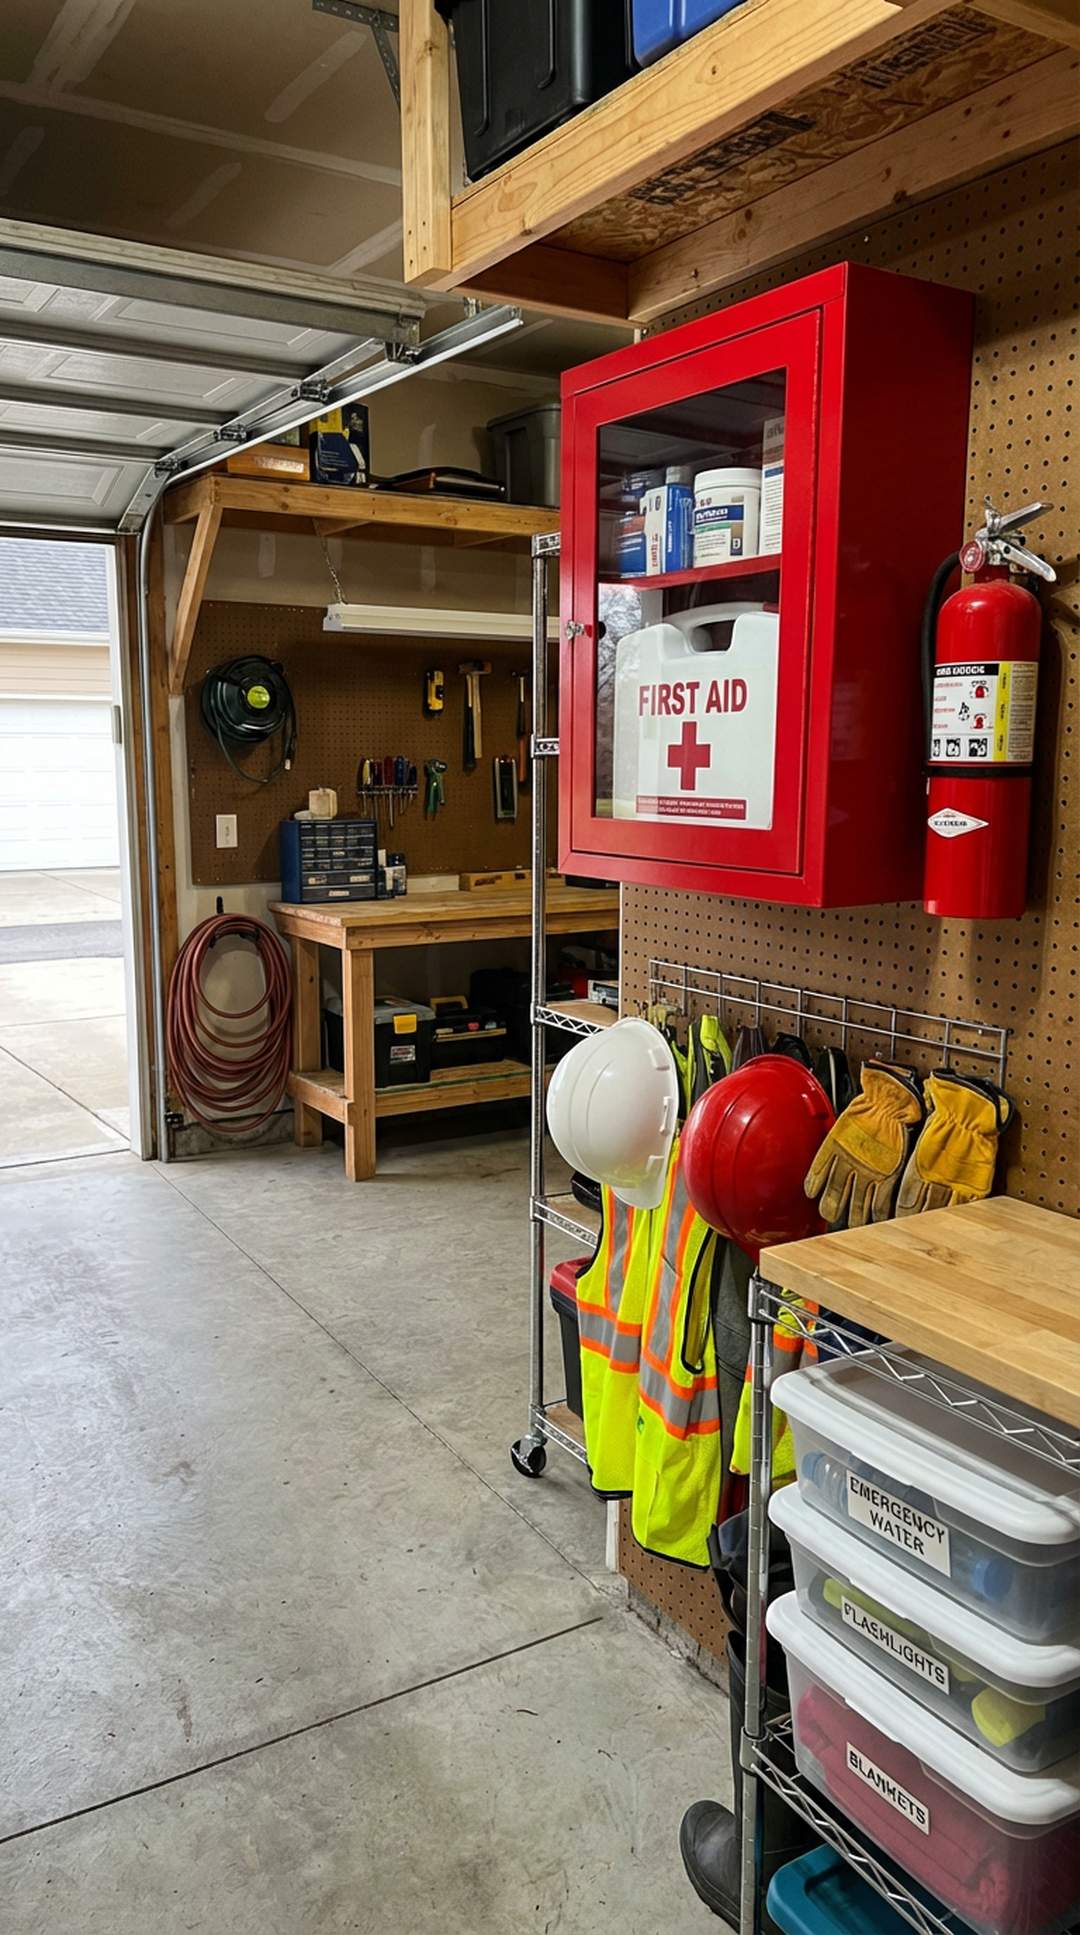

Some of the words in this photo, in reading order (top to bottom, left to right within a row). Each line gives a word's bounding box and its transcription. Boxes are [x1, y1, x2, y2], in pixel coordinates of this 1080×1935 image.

[639, 681, 701, 716] FIRST
[705, 678, 748, 714] AID
[850, 1476, 945, 1544] EMERGENCY
[869, 1509, 925, 1555] WATER
